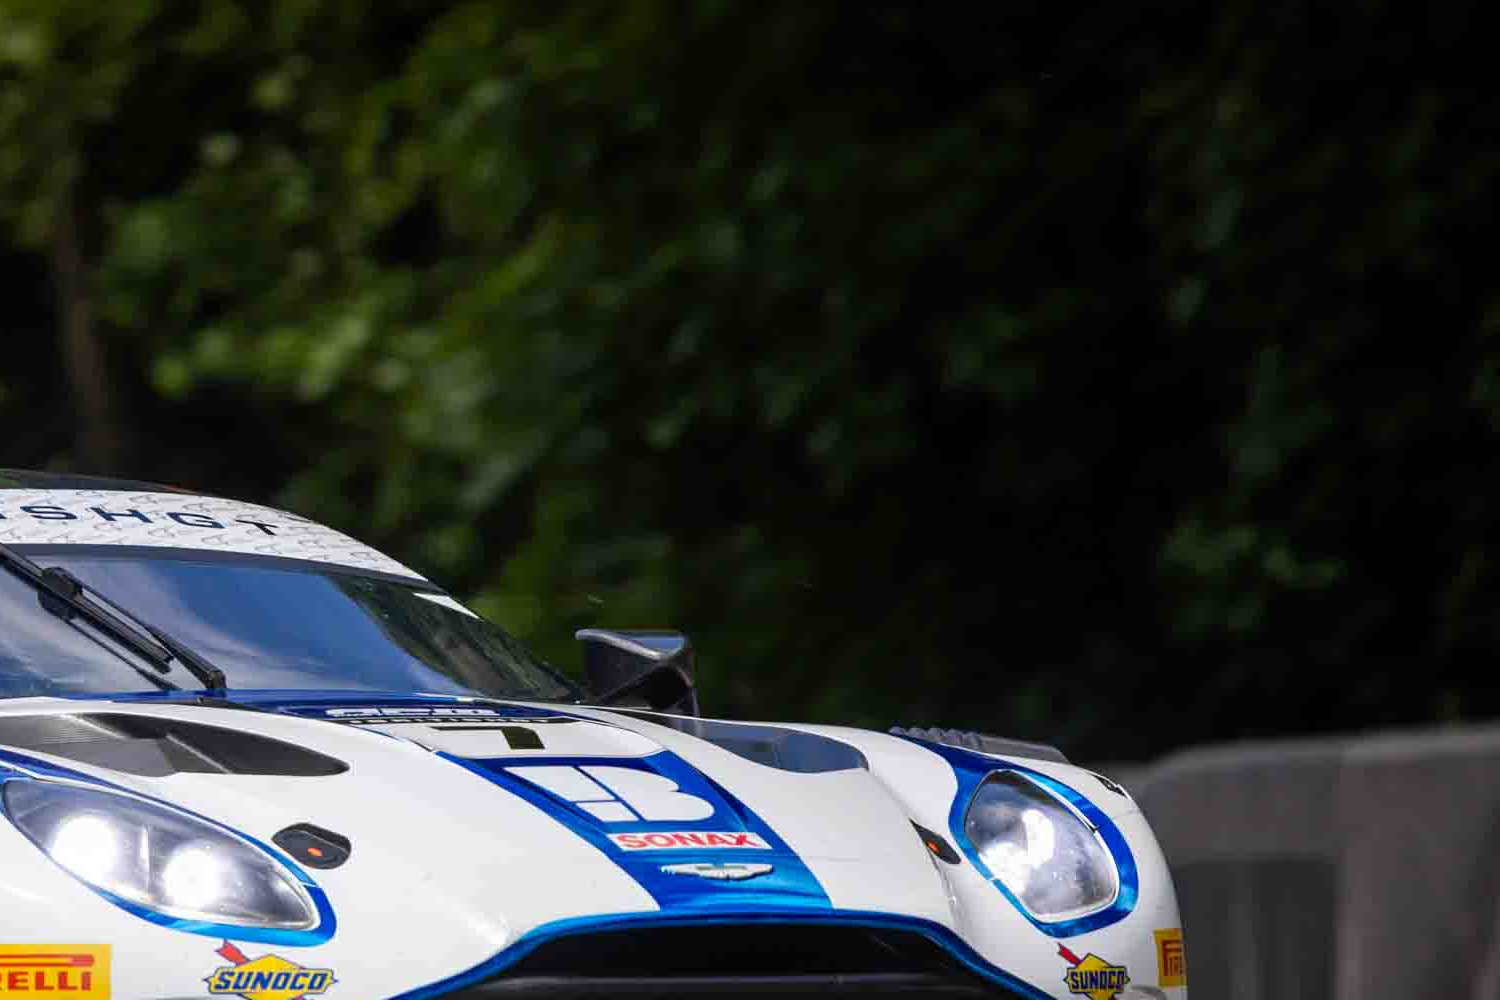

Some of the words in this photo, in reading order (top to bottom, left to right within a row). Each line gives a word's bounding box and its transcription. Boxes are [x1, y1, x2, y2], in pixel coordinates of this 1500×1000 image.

[431, 725, 546, 750] 7
[615, 832, 759, 849] SONAX
[214, 971, 329, 992] SUNOCO
[1070, 970, 1125, 990] SUNOCO
